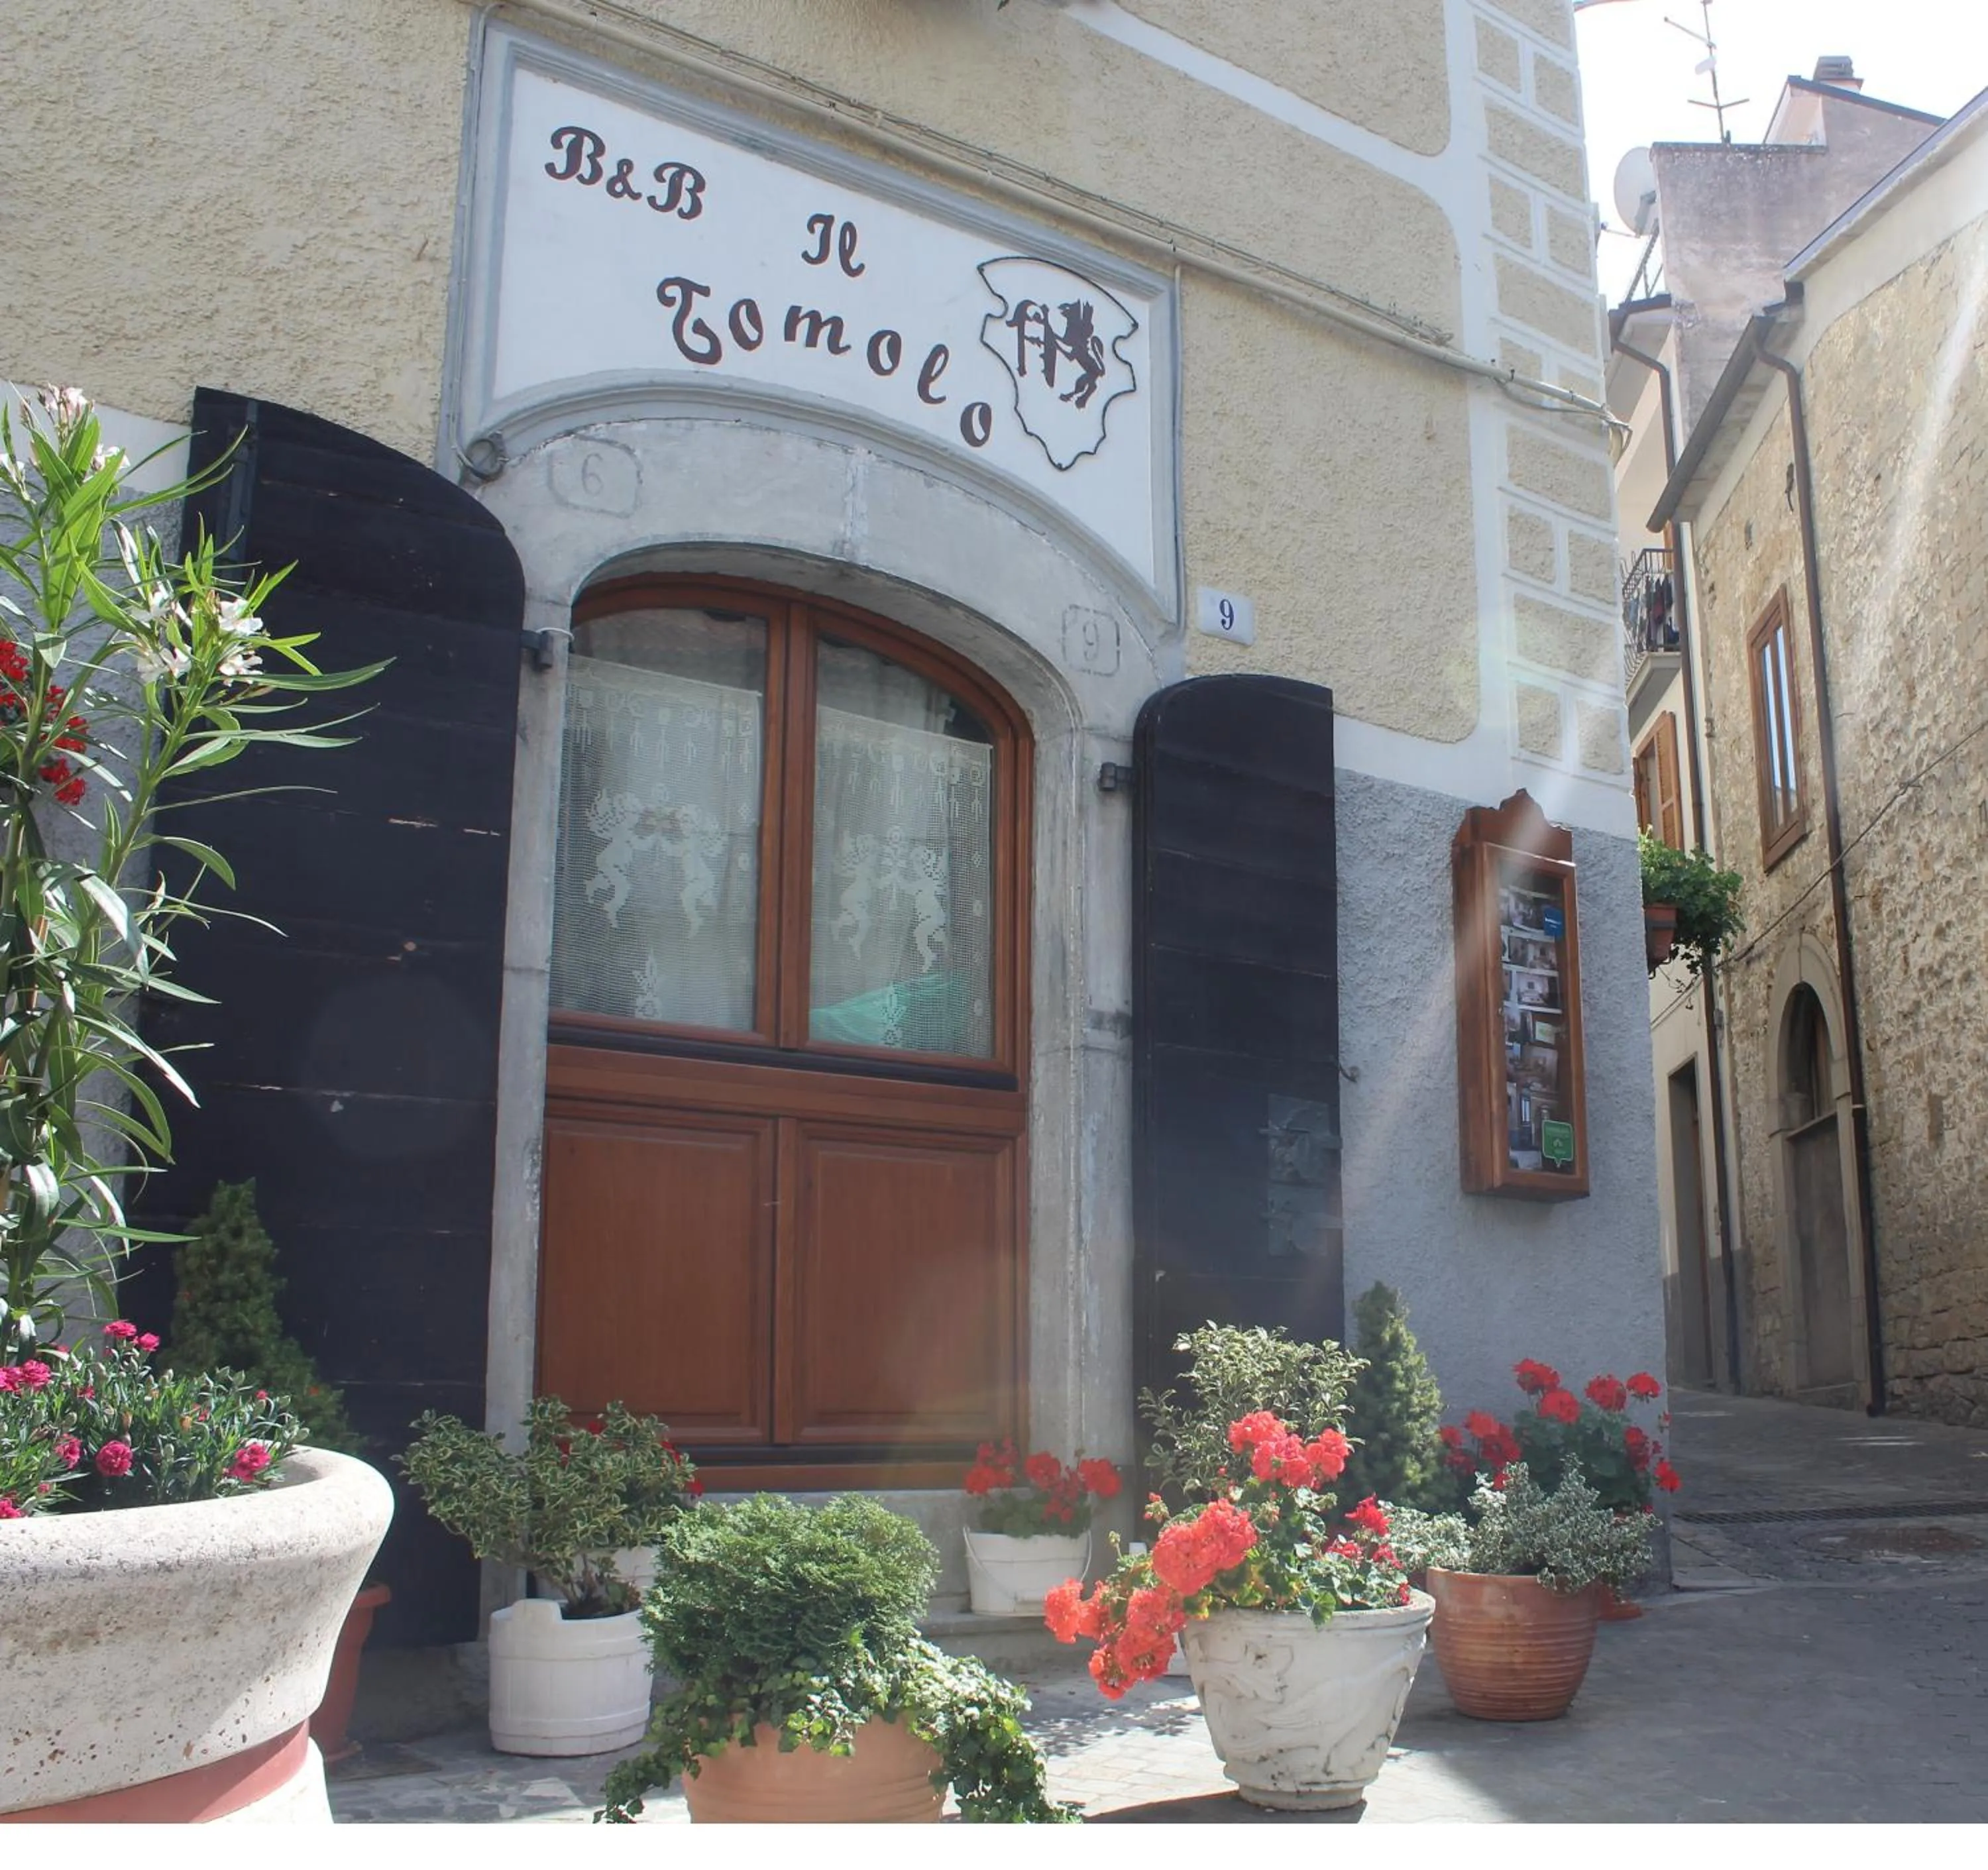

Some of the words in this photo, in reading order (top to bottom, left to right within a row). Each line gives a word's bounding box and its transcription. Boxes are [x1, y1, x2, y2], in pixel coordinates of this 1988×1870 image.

[545, 125, 706, 220] B&B
[801, 213, 865, 278] Il
[655, 276, 993, 448] Tomolo
[580, 452, 604, 497] 6
[1219, 598, 1235, 631] 9
